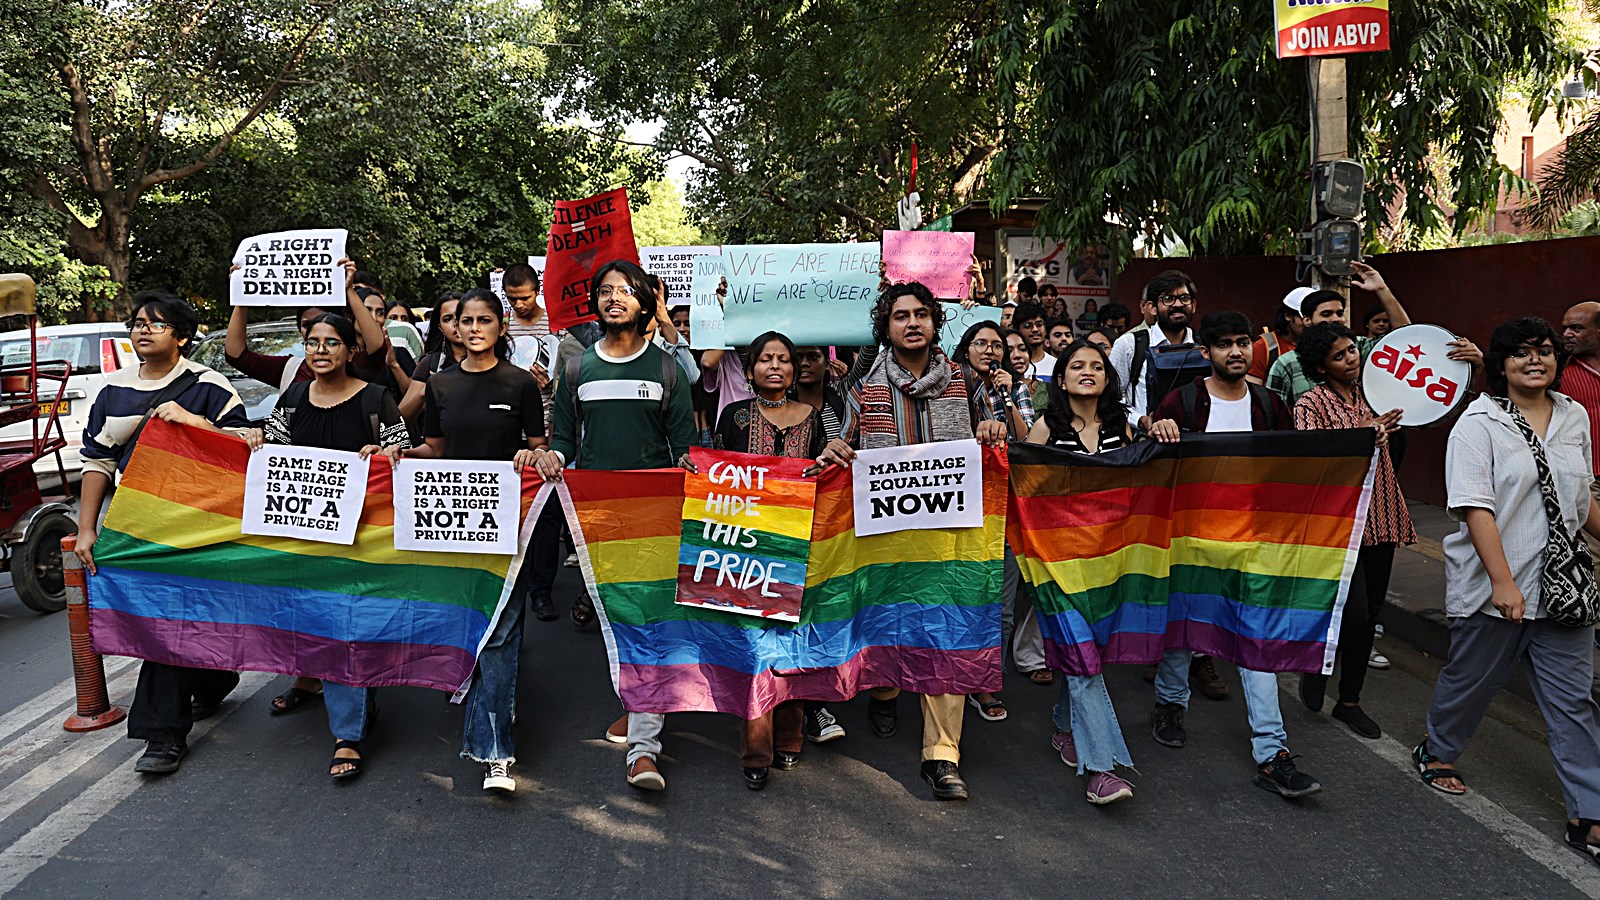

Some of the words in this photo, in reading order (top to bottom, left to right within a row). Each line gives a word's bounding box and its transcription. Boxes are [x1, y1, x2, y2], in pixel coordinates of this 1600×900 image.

[1287, 26, 1329, 51] JOIN
[1334, 22, 1381, 47] ABVP
[551, 197, 616, 225] SILENCE
[245, 242, 262, 253] A
[268, 238, 333, 251] RIGHT
[552, 222, 612, 252] DEATH
[244, 254, 333, 266] DELAYED
[648, 262, 678, 270] FOLKS
[729, 251, 777, 276] WE
[790, 252, 829, 273] ARE
[838, 252, 880, 274] HERE
[243, 268, 259, 278] IS
[264, 268, 277, 278] A
[283, 268, 333, 279] RIGHT
[243, 281, 333, 296] DENIED!
[561, 277, 595, 301] ACT
[730, 283, 766, 305] WE
[776, 283, 808, 301] ARE
[574, 300, 596, 318] LI
[695, 293, 720, 307] UNT
[1370, 343, 1459, 407] aisa
[268, 456, 313, 470] SAME
[317, 461, 349, 474] SEX
[869, 457, 965, 475] MARRIAGE
[267, 470, 347, 487] MARRIAGE
[414, 471, 462, 483] SAME
[468, 472, 499, 484] SEX
[708, 460, 769, 490] CAN'T
[869, 473, 965, 492] EQUALITY
[266, 482, 281, 493] IS
[286, 484, 297, 494] A
[301, 485, 344, 499] RIGHT
[414, 485, 499, 497] MARRIAGE
[264, 495, 313, 514] NOT
[320, 501, 340, 518] A
[414, 498, 428, 508] IS
[434, 498, 446, 508] A
[452, 499, 499, 509] RIGHT
[705, 491, 761, 516] HIDE
[870, 490, 965, 519] NOW!
[263, 514, 339, 531] PRIVILEGE!
[414, 511, 469, 528] NOT
[478, 512, 498, 529] A
[414, 530, 498, 542] PRIVILEGE!
[701, 518, 758, 548] THIS
[693, 550, 786, 597] PRIDE
